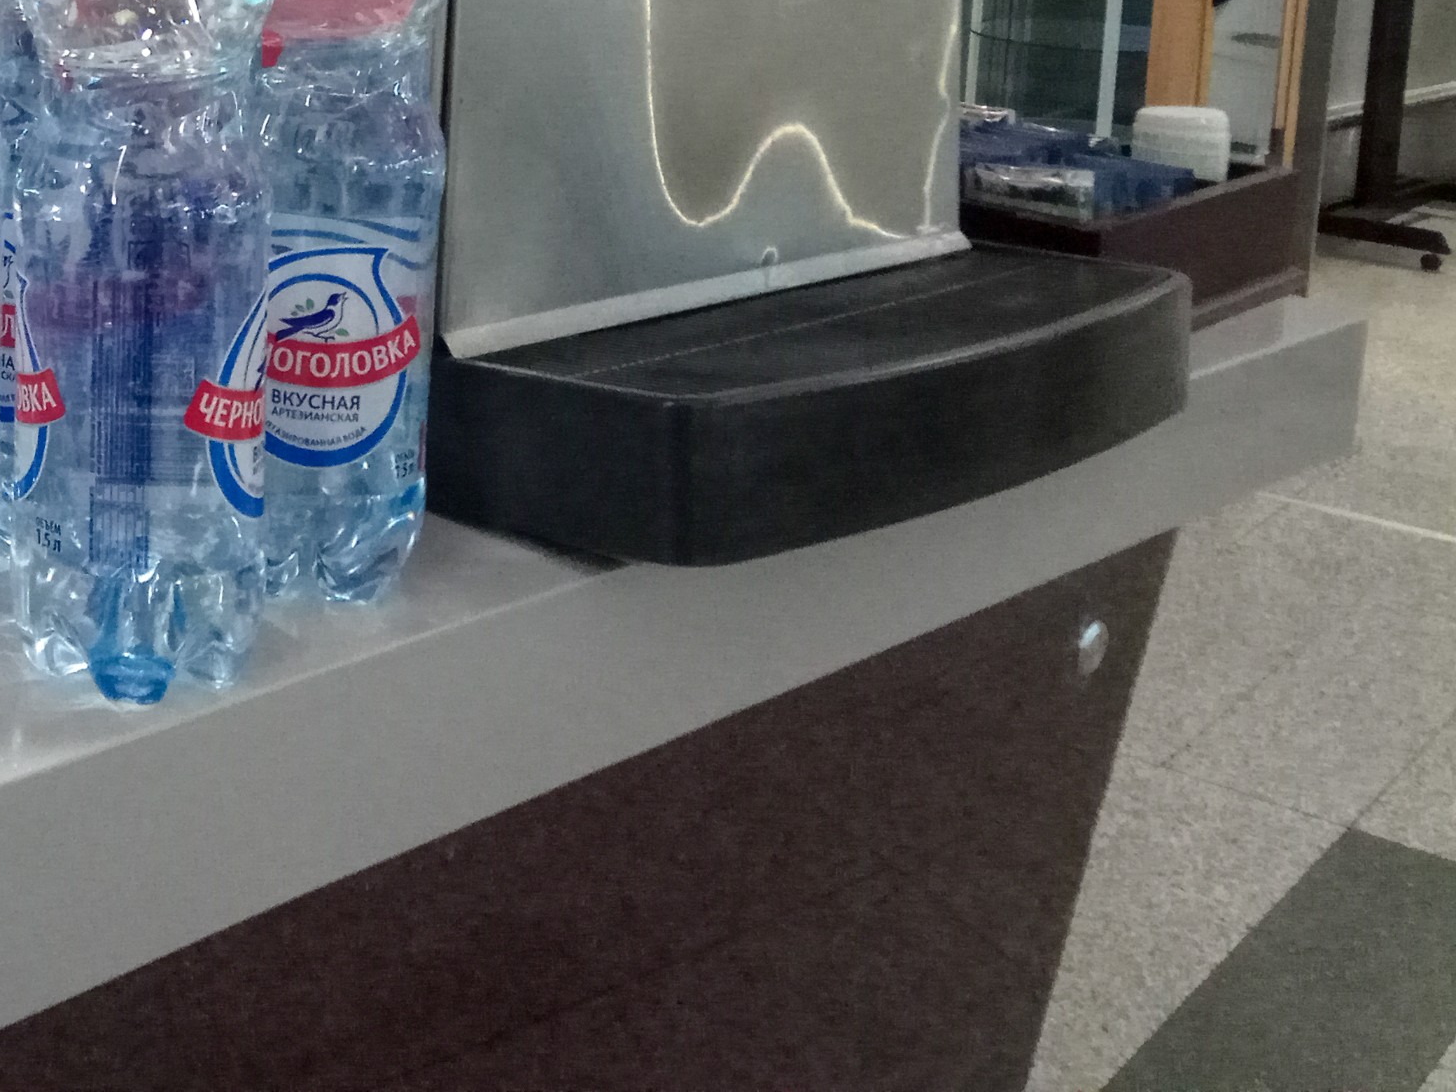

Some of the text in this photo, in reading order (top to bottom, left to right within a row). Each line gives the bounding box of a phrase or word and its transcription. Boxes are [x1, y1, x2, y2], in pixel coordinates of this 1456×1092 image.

[271, 388, 362, 411] ВКУСНАЯ
[271, 406, 360, 423] АРТЕЗИАНСКАЯ
[343, 425, 366, 444] ВОДА
